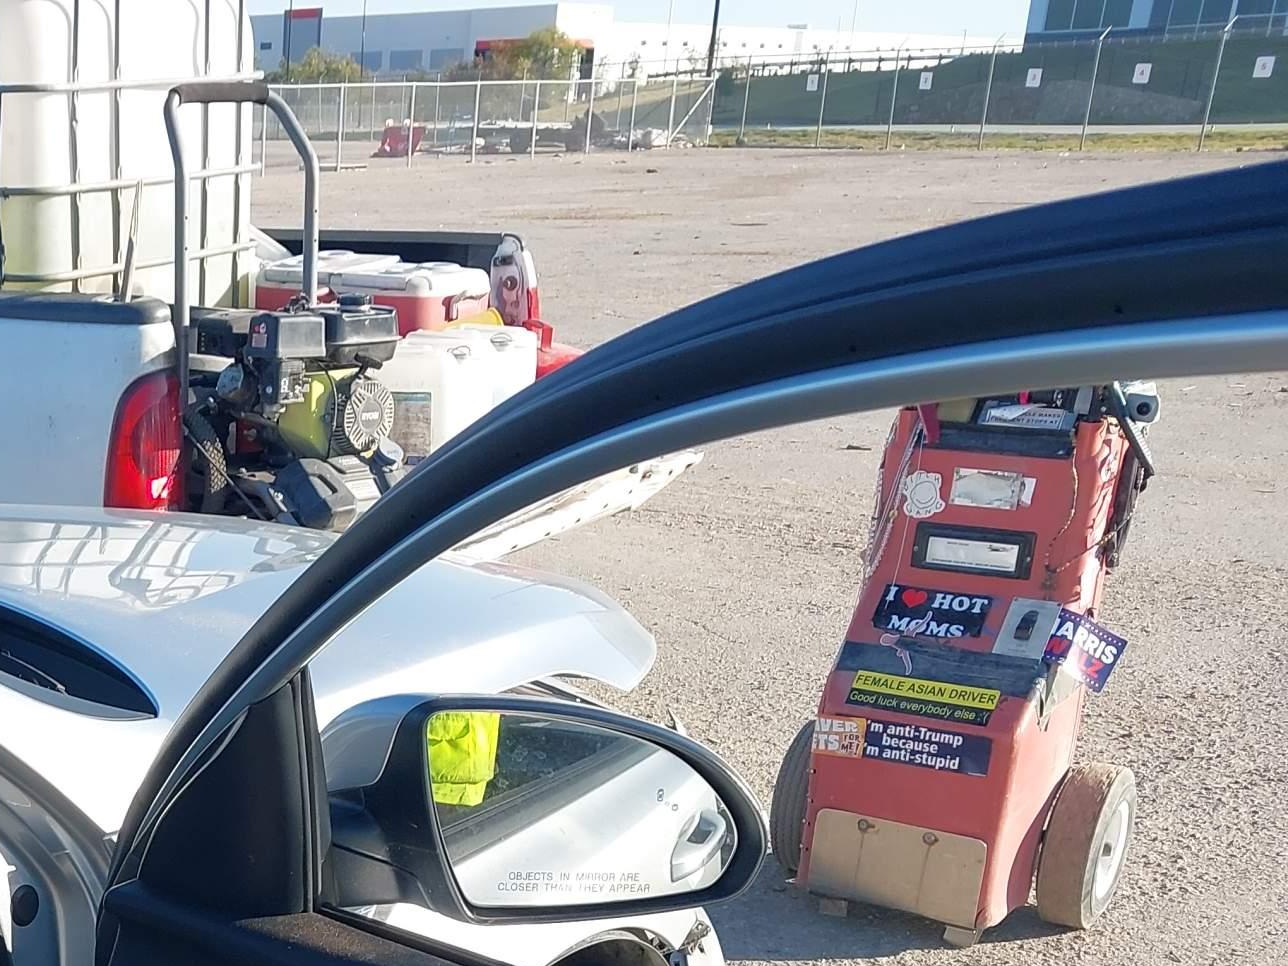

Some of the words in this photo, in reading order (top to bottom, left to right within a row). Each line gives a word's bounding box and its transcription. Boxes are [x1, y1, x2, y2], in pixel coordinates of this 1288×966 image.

[886, 587, 899, 601] I
[931, 593, 989, 613] HOT
[887, 615, 965, 637] MOMS
[856, 674, 906, 691] FEMALE
[907, 682, 946, 698] ASIAN
[948, 688, 997, 705] DRIVER
[850, 690, 876, 704] Good
[877, 694, 898, 708] luck
[900, 700, 953, 717] everybody
[954, 708, 976, 720] else
[882, 733, 939, 754] because
[886, 723, 964, 747] anti-Trump
[882, 748, 960, 770] anti-stupid
[497, 882, 539, 892] CLOSER
[545, 883, 572, 892] THAN
[578, 883, 605, 892] THEY
[609, 883, 651, 893] APPEAR
[508, 871, 553, 881] OBJECTS
[559, 872, 570, 881] IN
[575, 872, 616, 882] MIRROR
[619, 872, 640, 882] ARE
